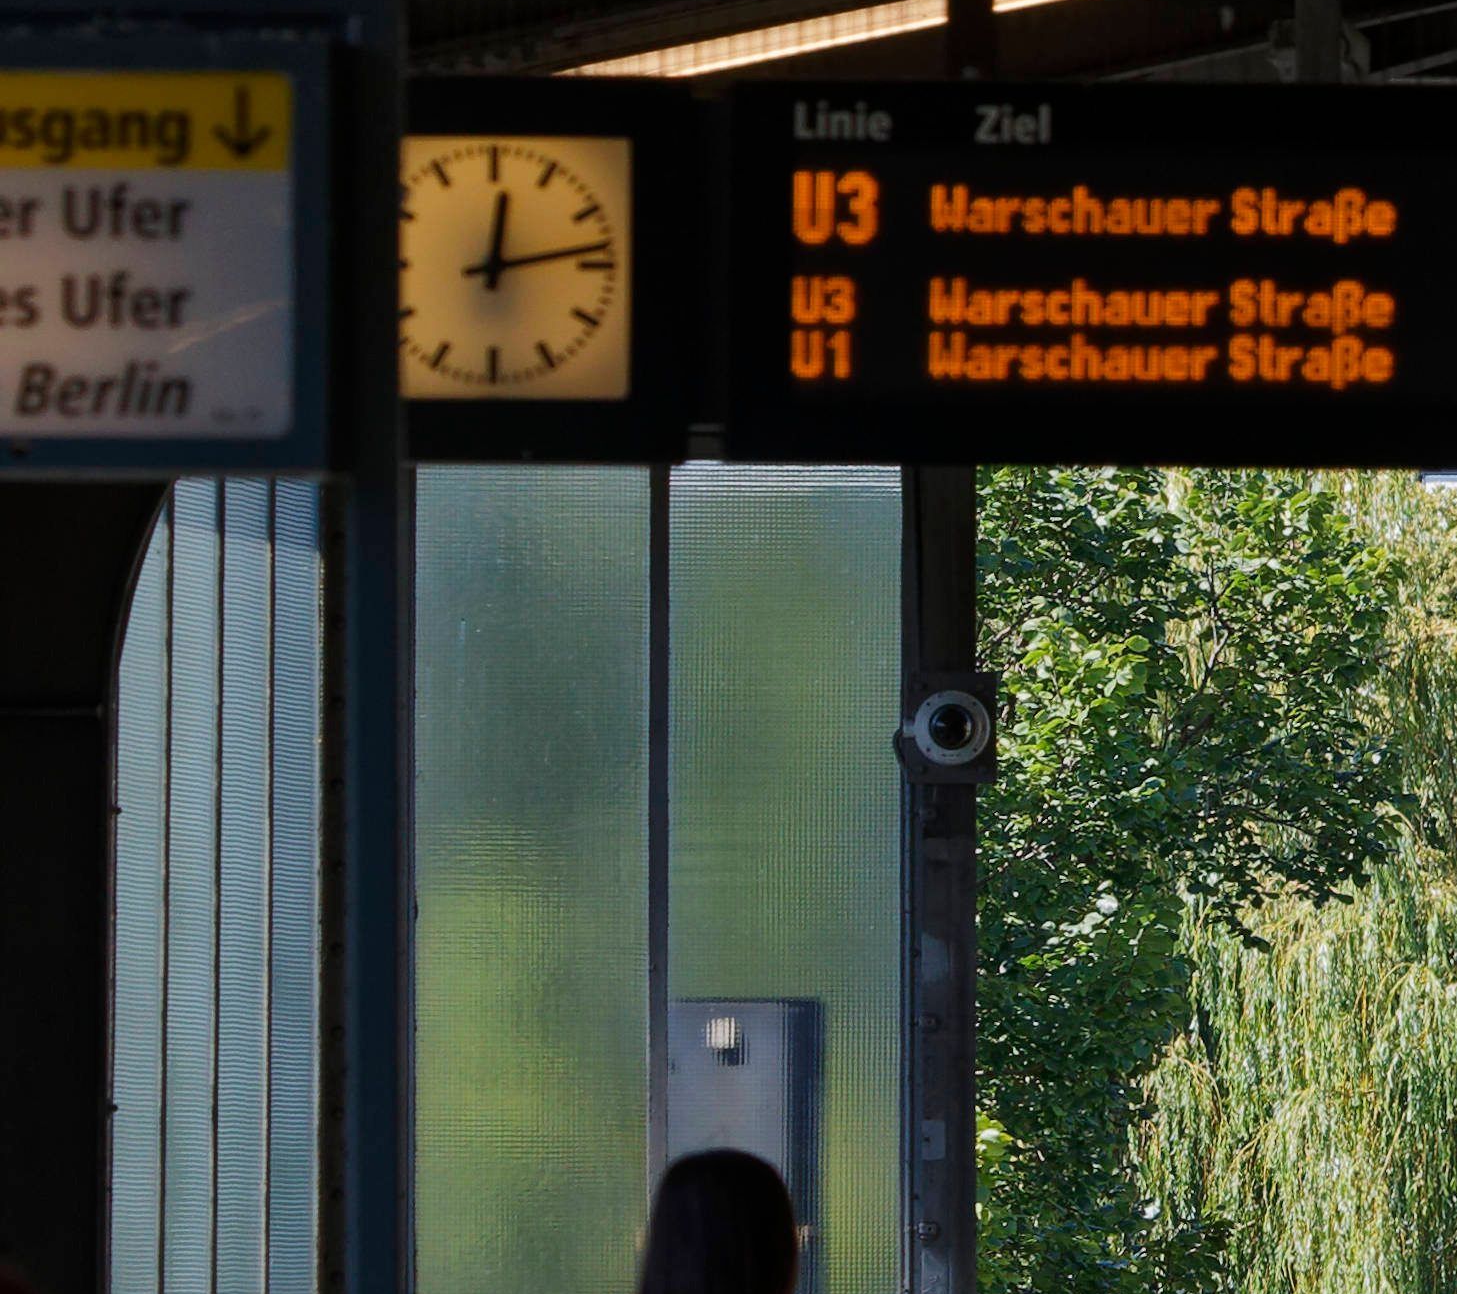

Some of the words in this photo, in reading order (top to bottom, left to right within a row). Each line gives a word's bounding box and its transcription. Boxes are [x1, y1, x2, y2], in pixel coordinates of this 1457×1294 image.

[795, 102, 892, 141] Linie
[974, 104, 1051, 144] Ziel
[63, 182, 190, 241] Ufer
[793, 171, 879, 245] U3
[931, 185, 1220, 235] Warschauer
[1231, 188, 1396, 244] Straße
[61, 270, 190, 330] Ufer
[792, 277, 855, 324] U3
[929, 278, 1220, 326] Warschauer
[1230, 279, 1395, 335] Straße
[791, 330, 850, 378] U1
[928, 332, 1218, 381] Warschauer
[1229, 333, 1393, 389] Straße
[16, 361, 193, 418] Berlin
